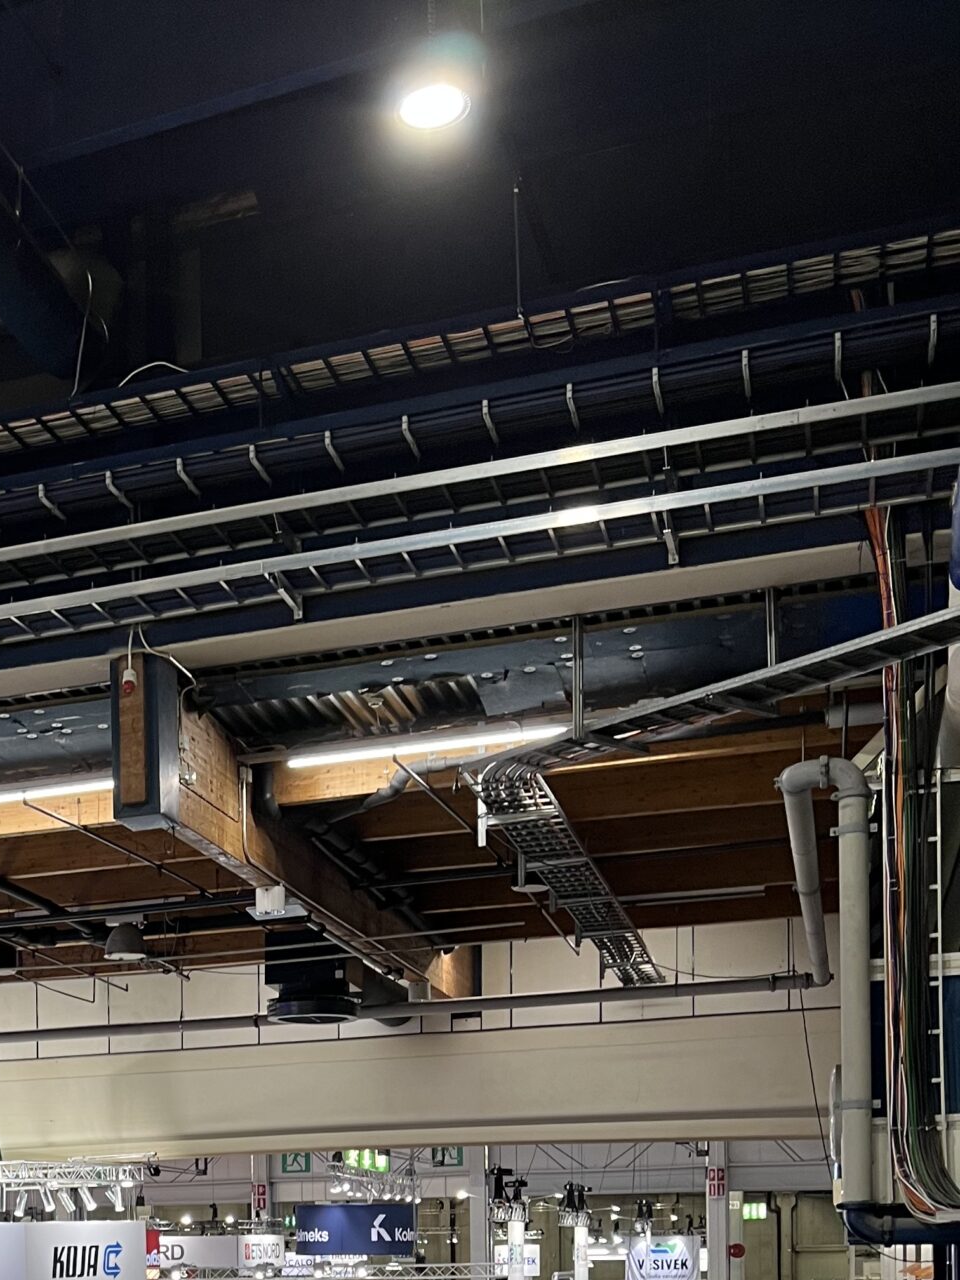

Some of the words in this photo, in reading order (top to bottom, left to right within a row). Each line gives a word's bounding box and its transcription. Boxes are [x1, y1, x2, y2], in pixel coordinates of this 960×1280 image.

[395, 1227, 417, 1242] Kolm
[159, 1244, 185, 1260] RD
[52, 1245, 99, 1279] KOJA
[638, 1258, 689, 1271] VSIVEK
